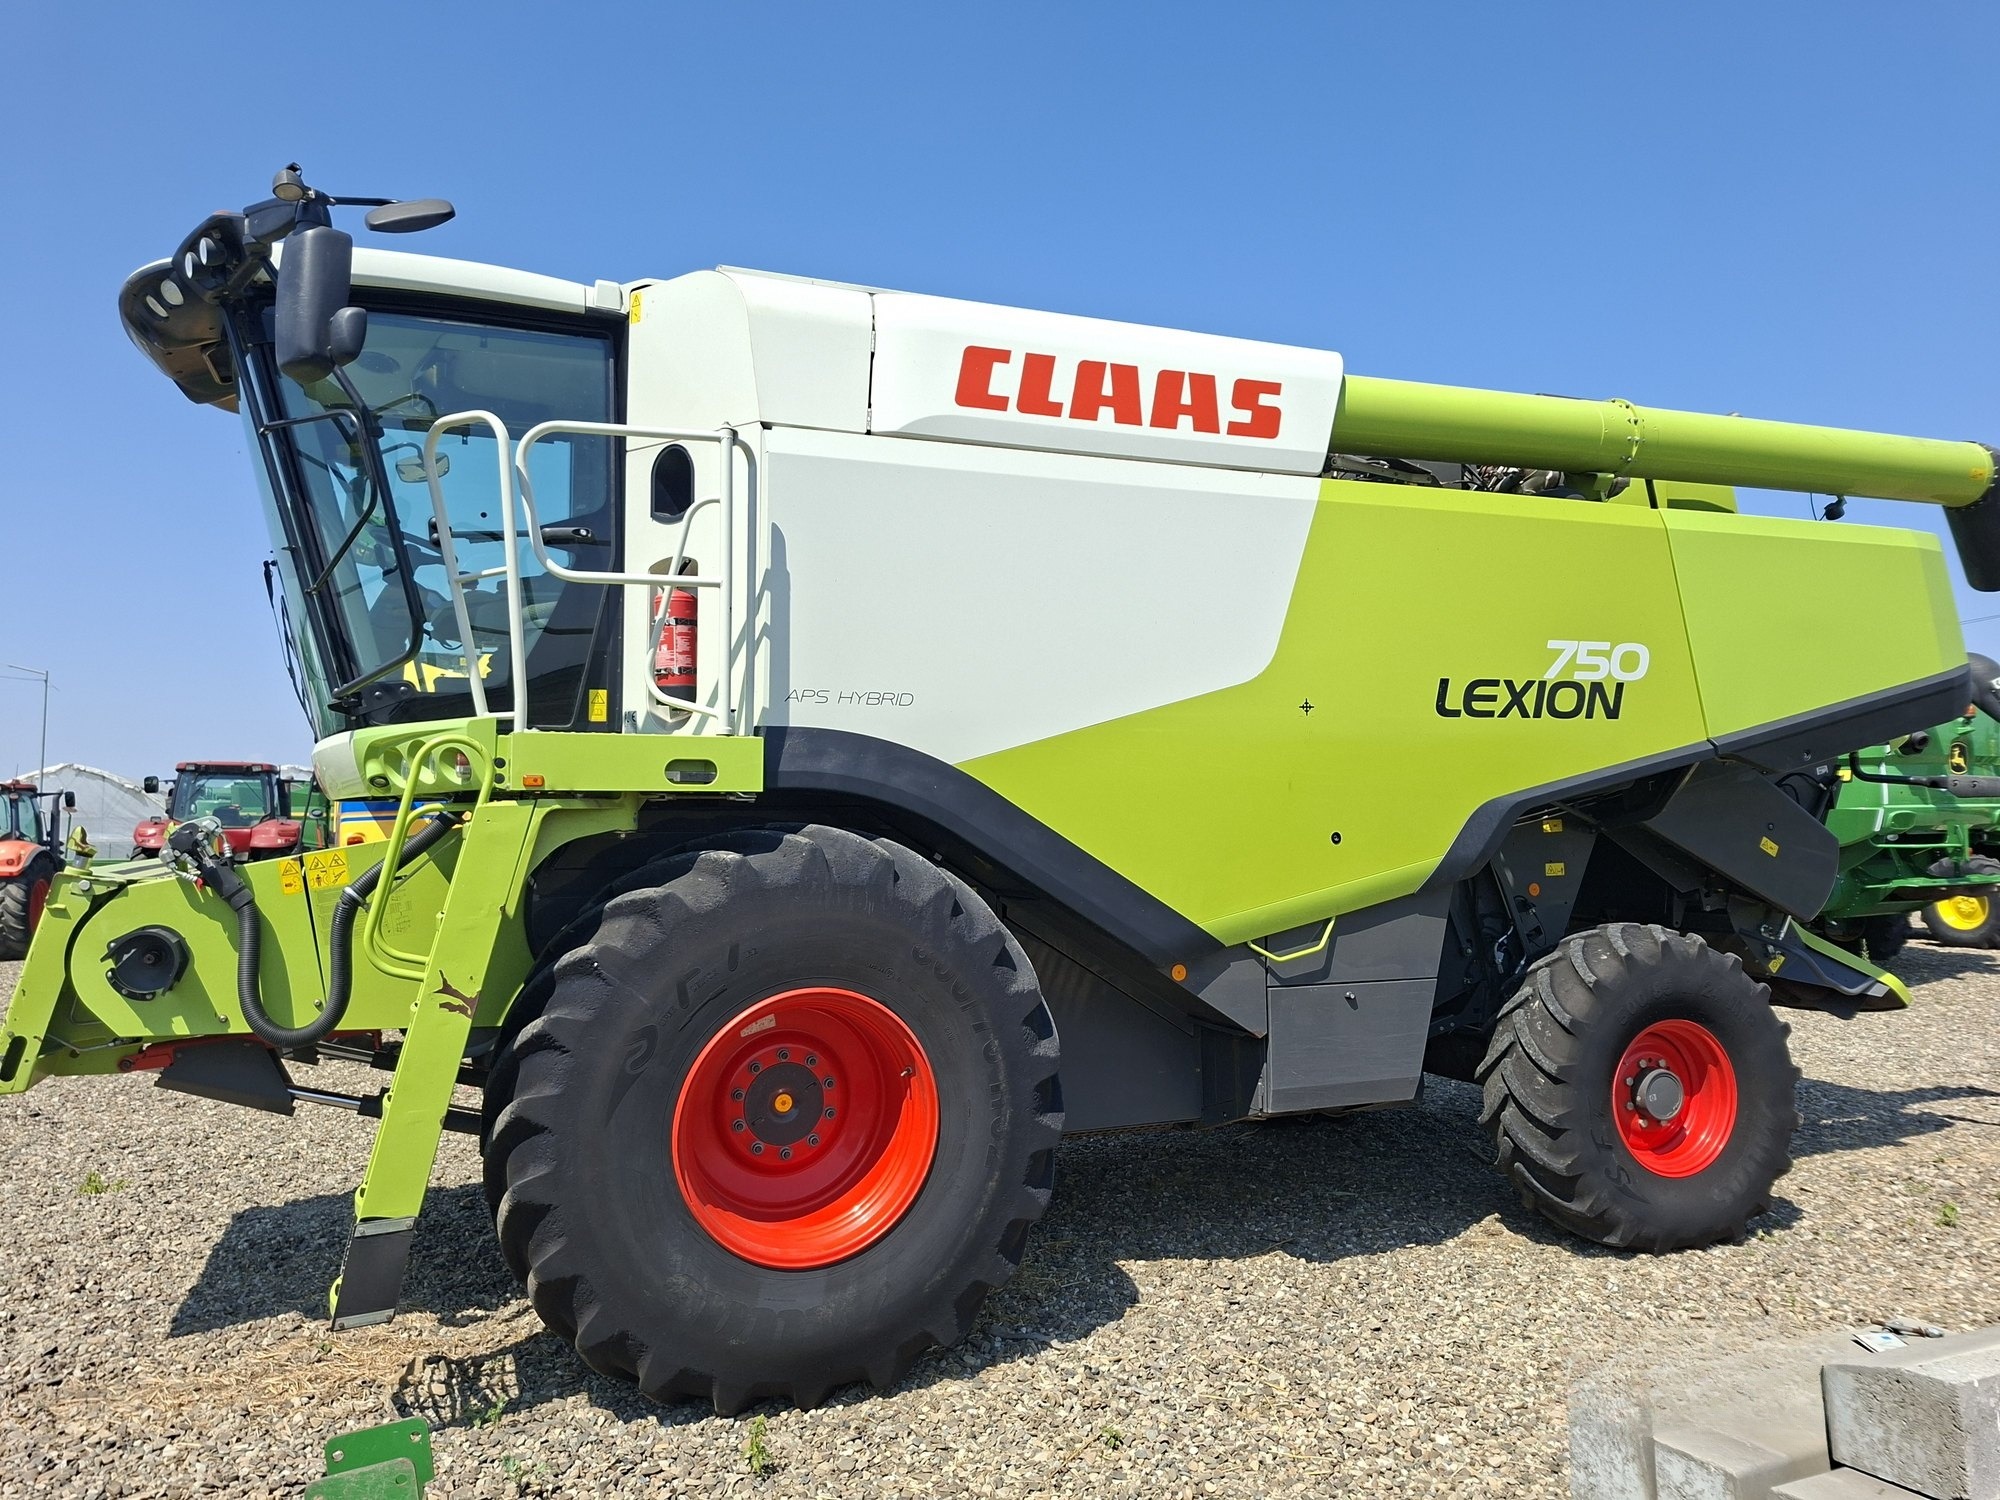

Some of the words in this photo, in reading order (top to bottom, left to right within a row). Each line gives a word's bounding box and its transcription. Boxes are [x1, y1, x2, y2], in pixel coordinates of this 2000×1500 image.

[955, 345, 1282, 439] CLAAS
[1544, 640, 1650, 681] 750
[784, 689, 830, 704] APS
[837, 691, 914, 706] HYBRID
[1435, 678, 1624, 719] LEXION
